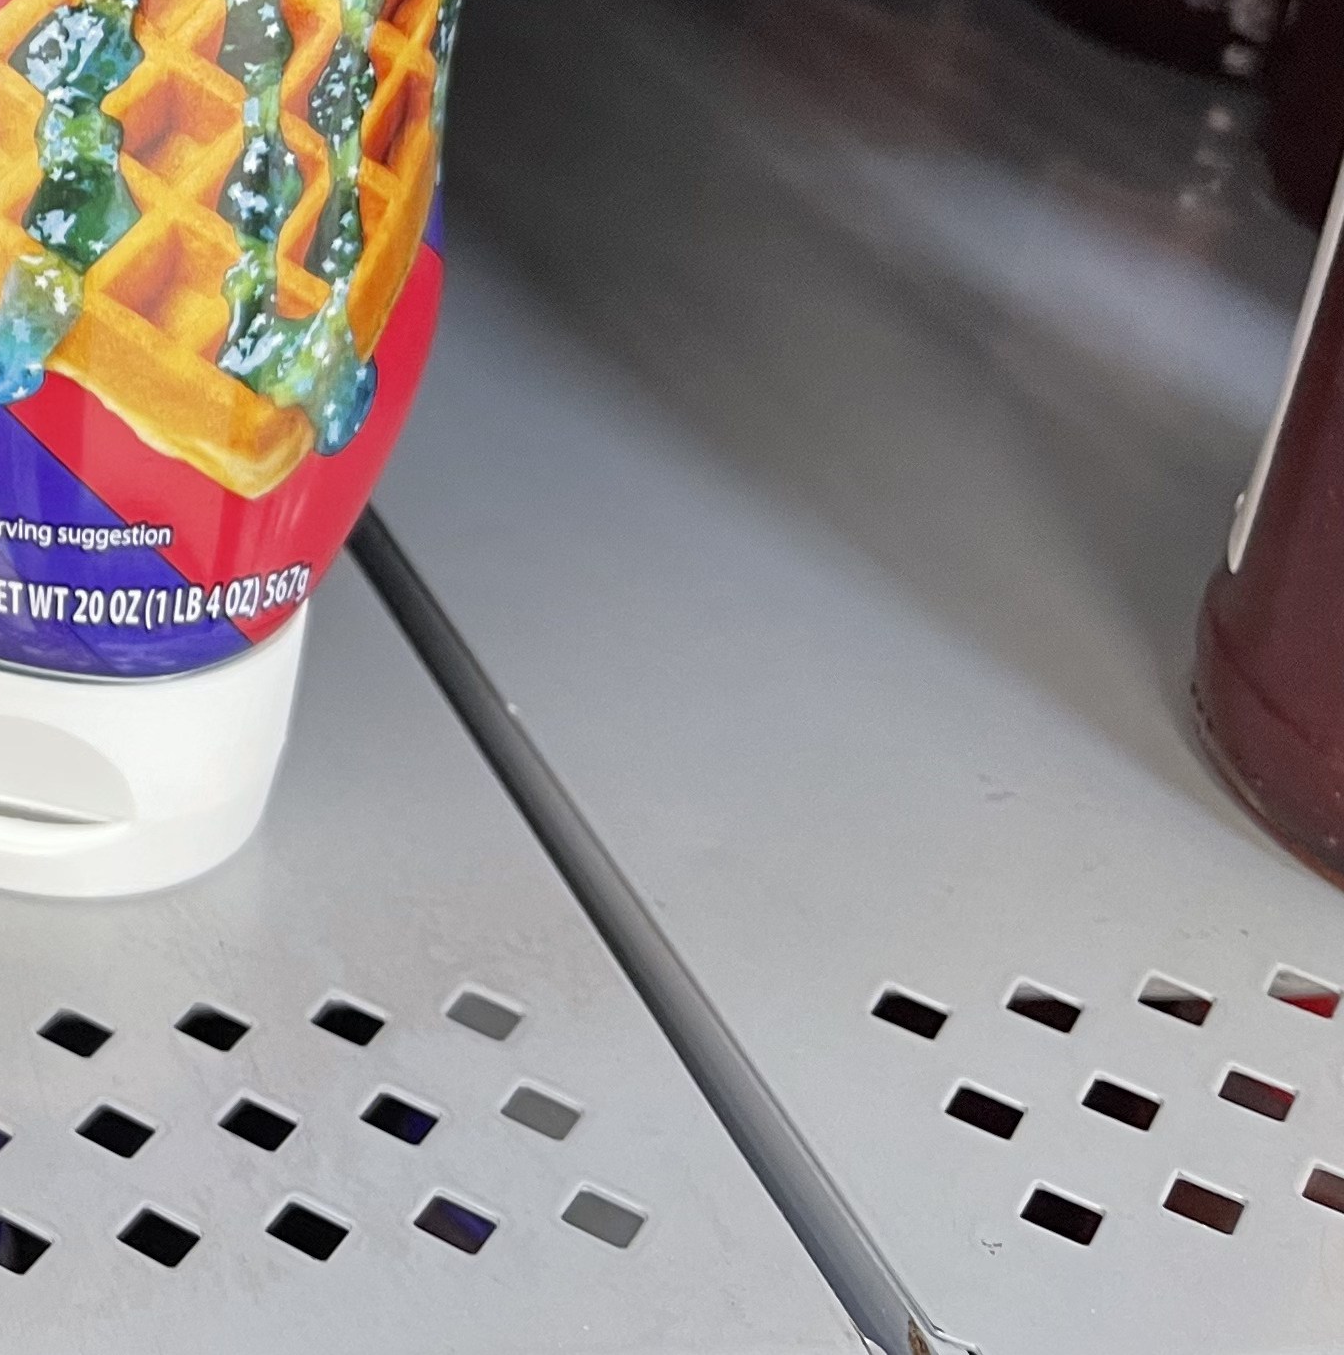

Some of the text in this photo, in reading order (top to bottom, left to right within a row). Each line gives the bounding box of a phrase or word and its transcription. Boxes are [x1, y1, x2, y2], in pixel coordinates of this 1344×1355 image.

[57, 520, 172, 551] suggestion
[29, 582, 69, 620] WT
[73, 589, 104, 624] 20
[109, 588, 141, 626] OZ
[145, 589, 167, 630] (1
[173, 587, 202, 624] LB
[206, 581, 221, 619] 4
[227, 575, 260, 619] OZ)
[262, 565, 311, 608] 567g
